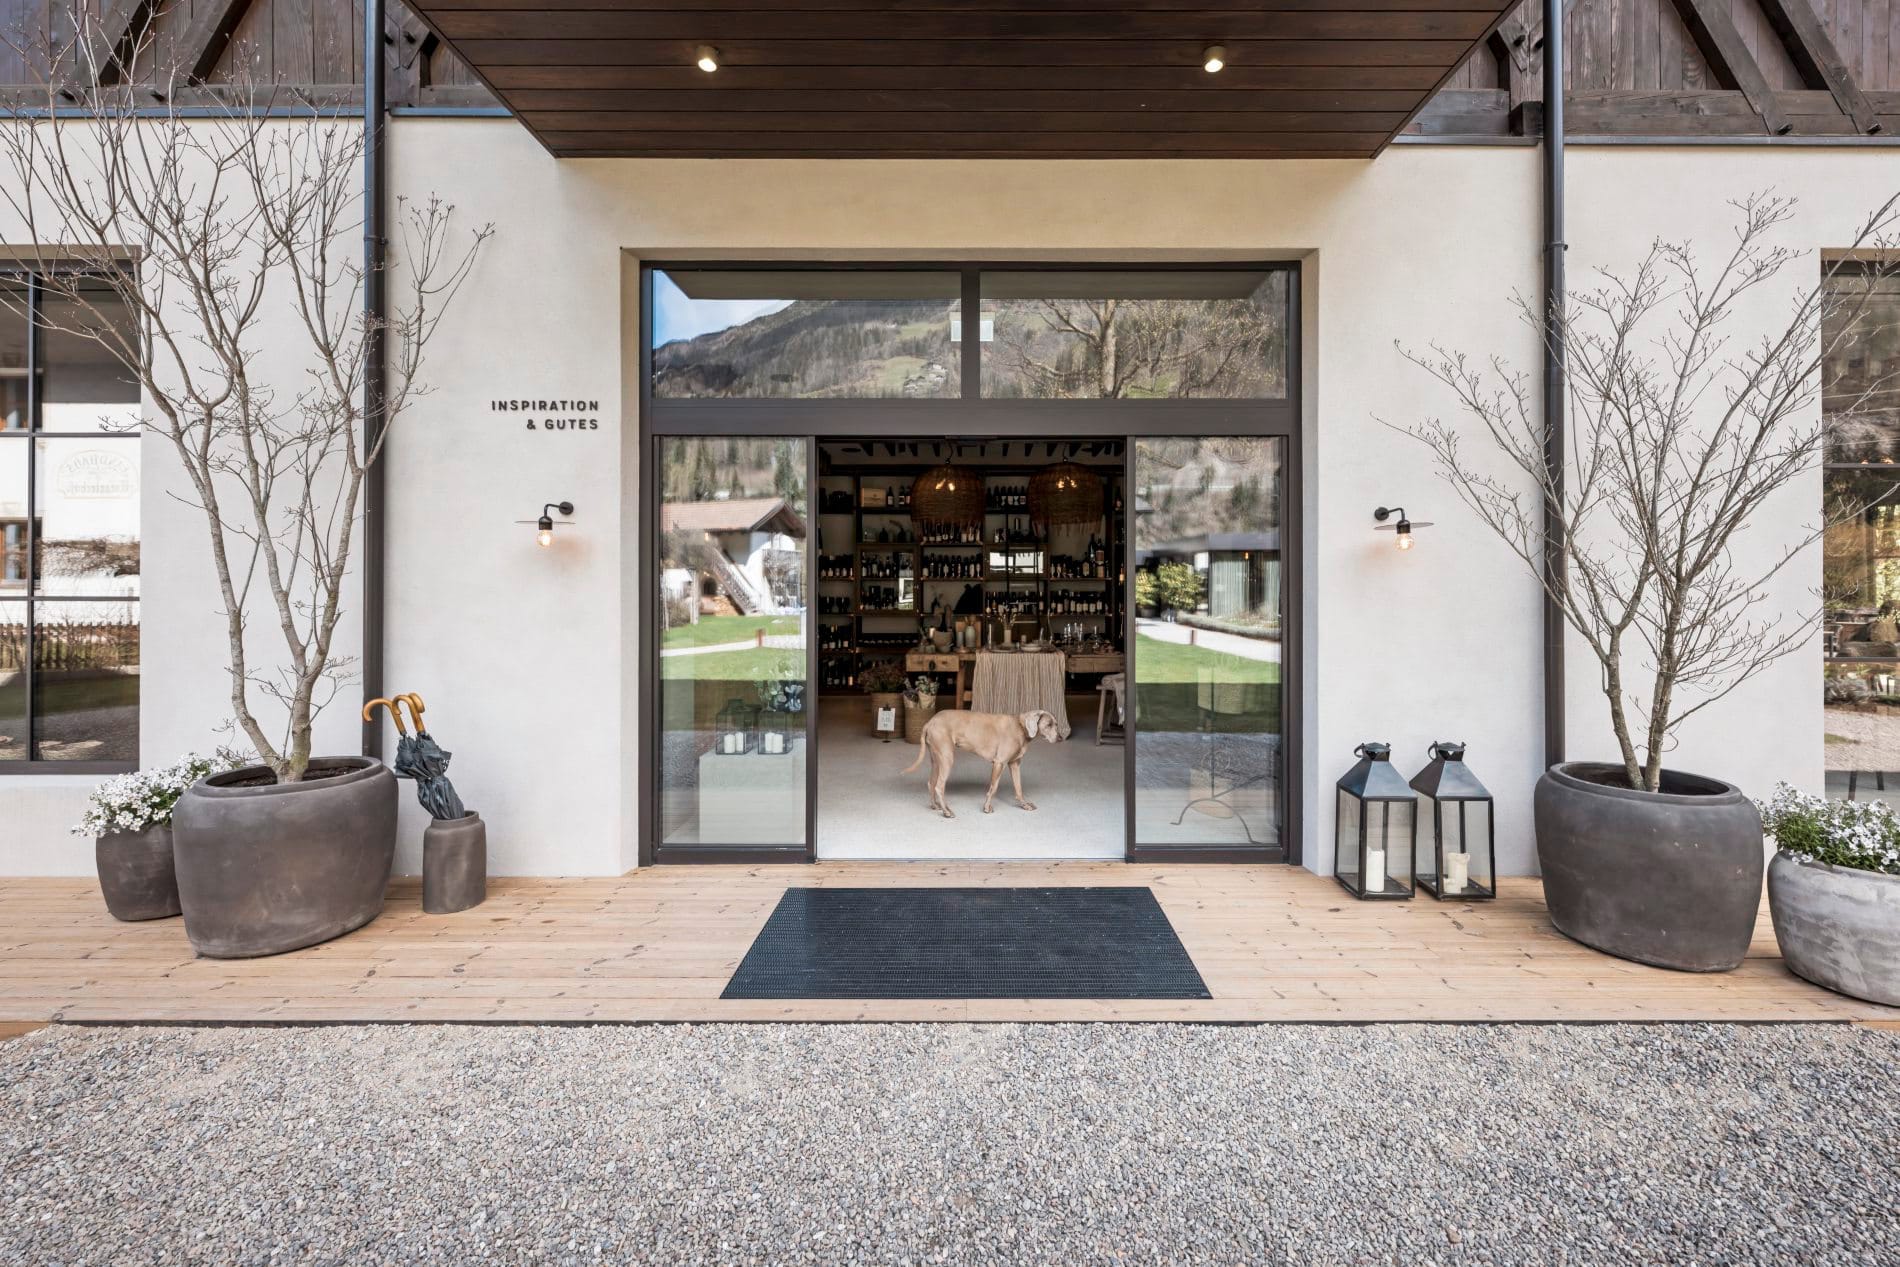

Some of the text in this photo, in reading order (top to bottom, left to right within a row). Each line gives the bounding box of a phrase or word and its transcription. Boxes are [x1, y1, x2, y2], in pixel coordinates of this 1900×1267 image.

[491, 400, 598, 411] INSPIRATION
[526, 419, 598, 430] & GUTES
